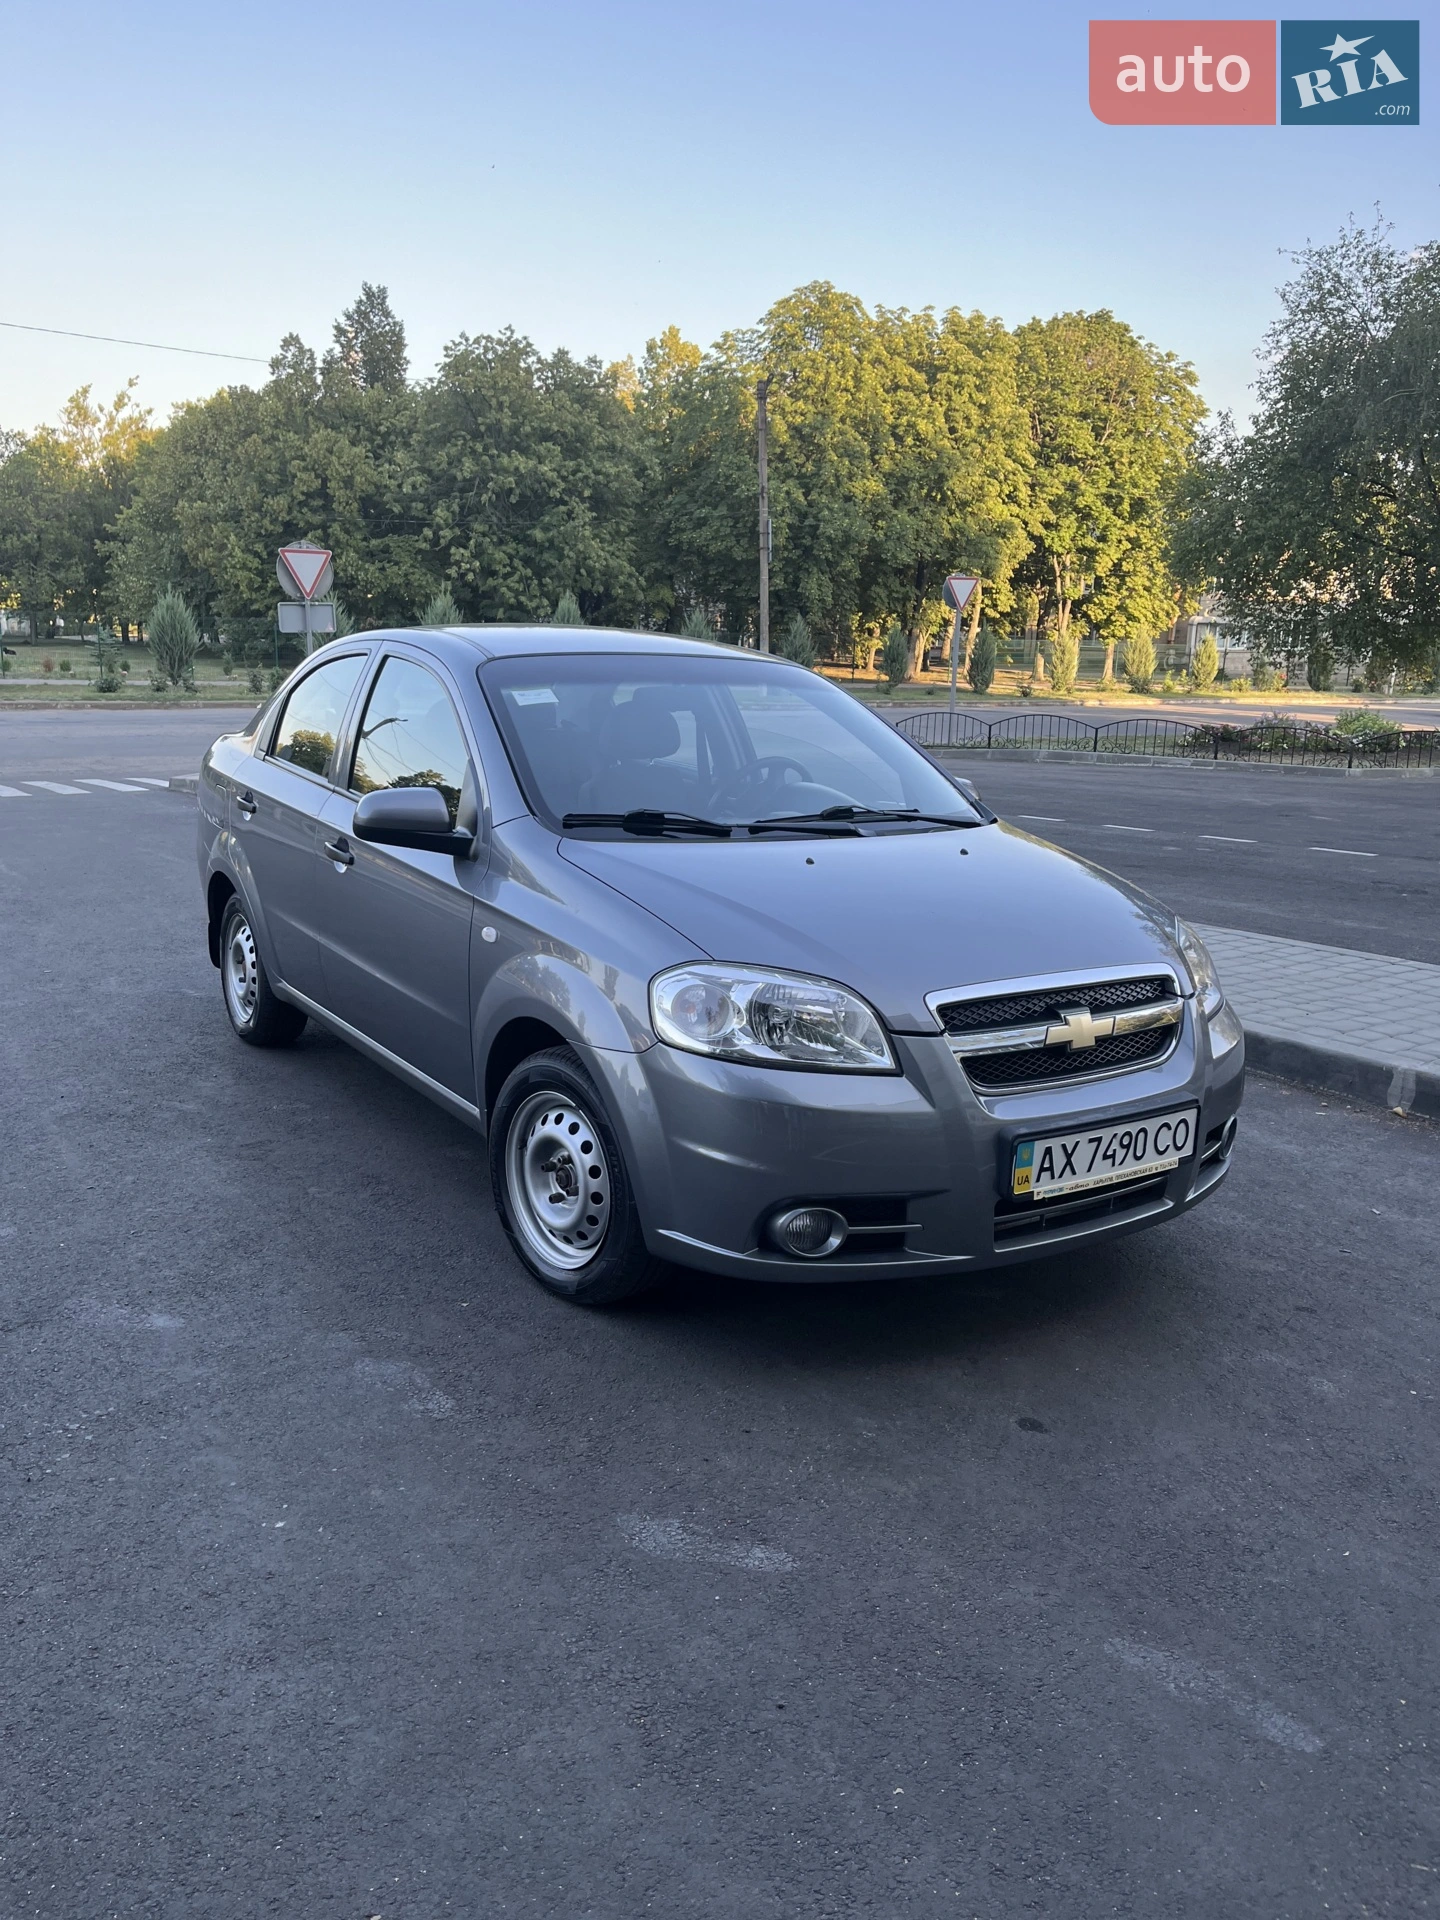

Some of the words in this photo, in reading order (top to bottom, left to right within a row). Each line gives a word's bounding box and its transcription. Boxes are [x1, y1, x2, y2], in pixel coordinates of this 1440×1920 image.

[1035, 1140, 1081, 1183] AX
[1086, 1126, 1149, 1173] 7490
[1153, 1117, 1190, 1156] CO
[1017, 1174, 1030, 1186] UA
